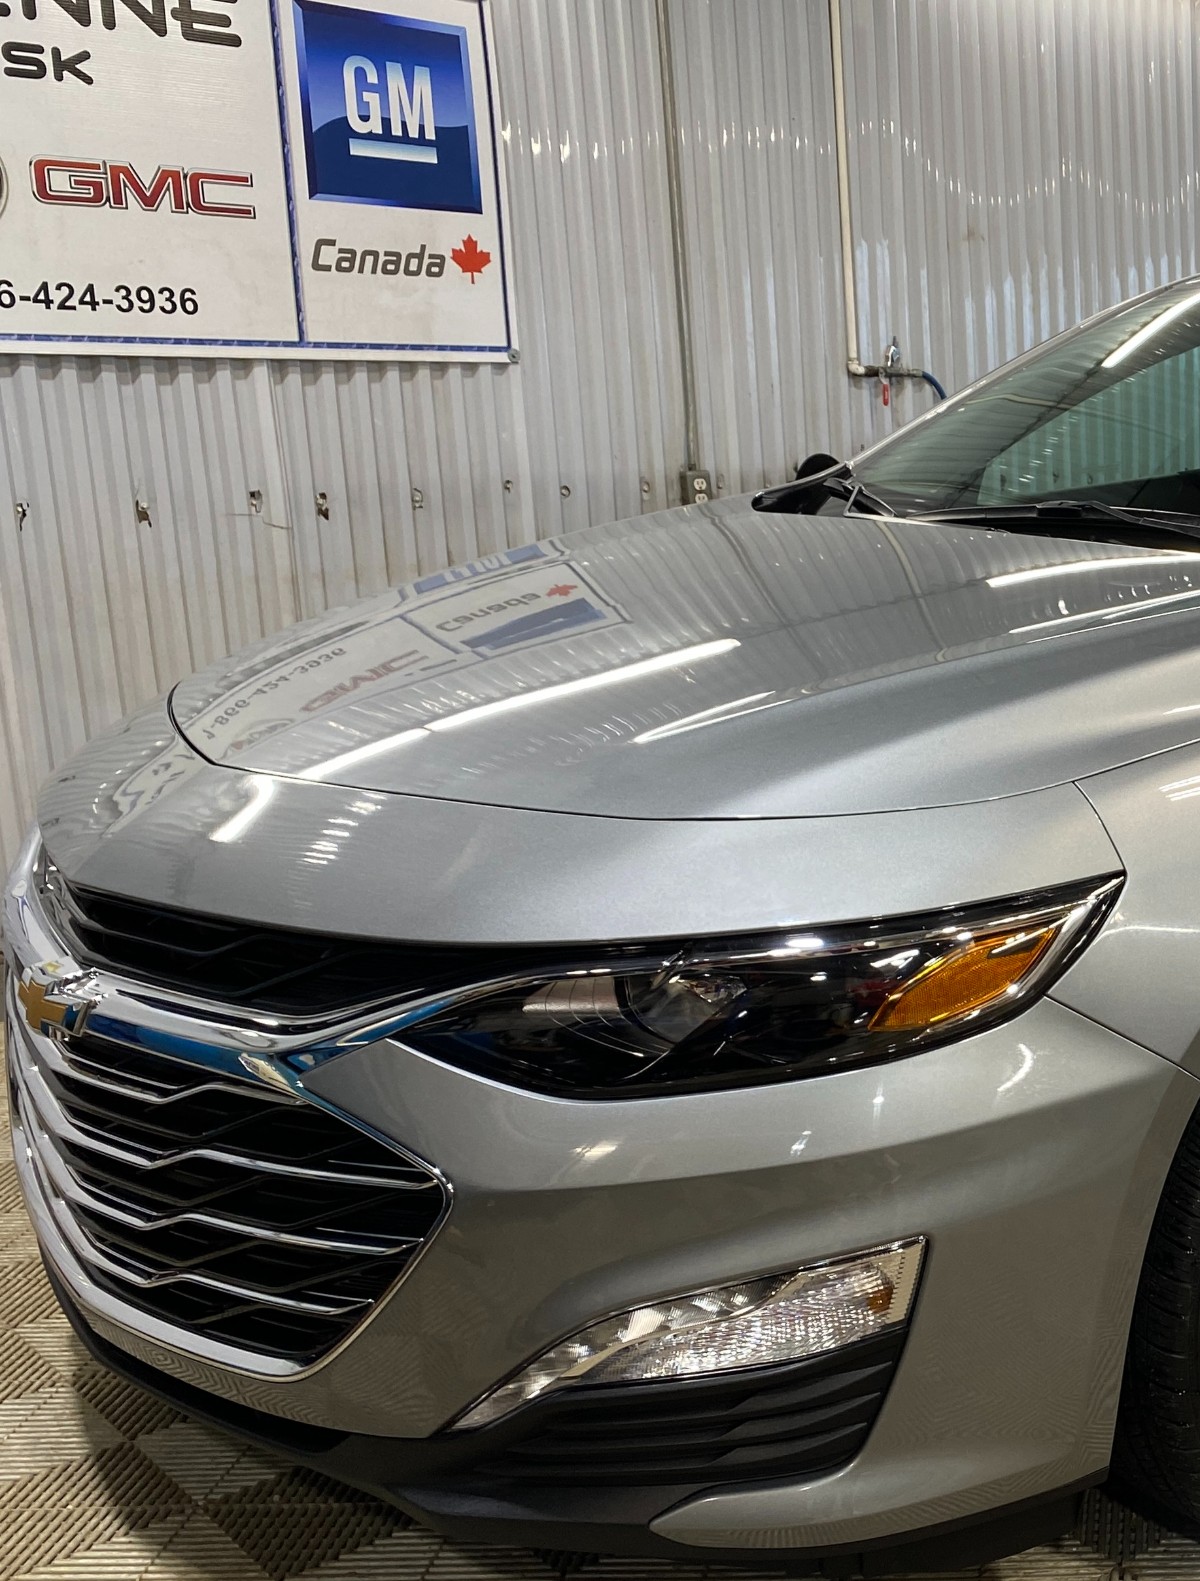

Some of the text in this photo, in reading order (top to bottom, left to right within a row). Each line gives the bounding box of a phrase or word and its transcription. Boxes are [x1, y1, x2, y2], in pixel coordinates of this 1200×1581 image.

[1, 41, 93, 85] SK
[343, 54, 437, 141] GM
[30, 154, 257, 219] GMC
[311, 238, 446, 278] Canada
[0, 279, 199, 315] 6-424-3936
